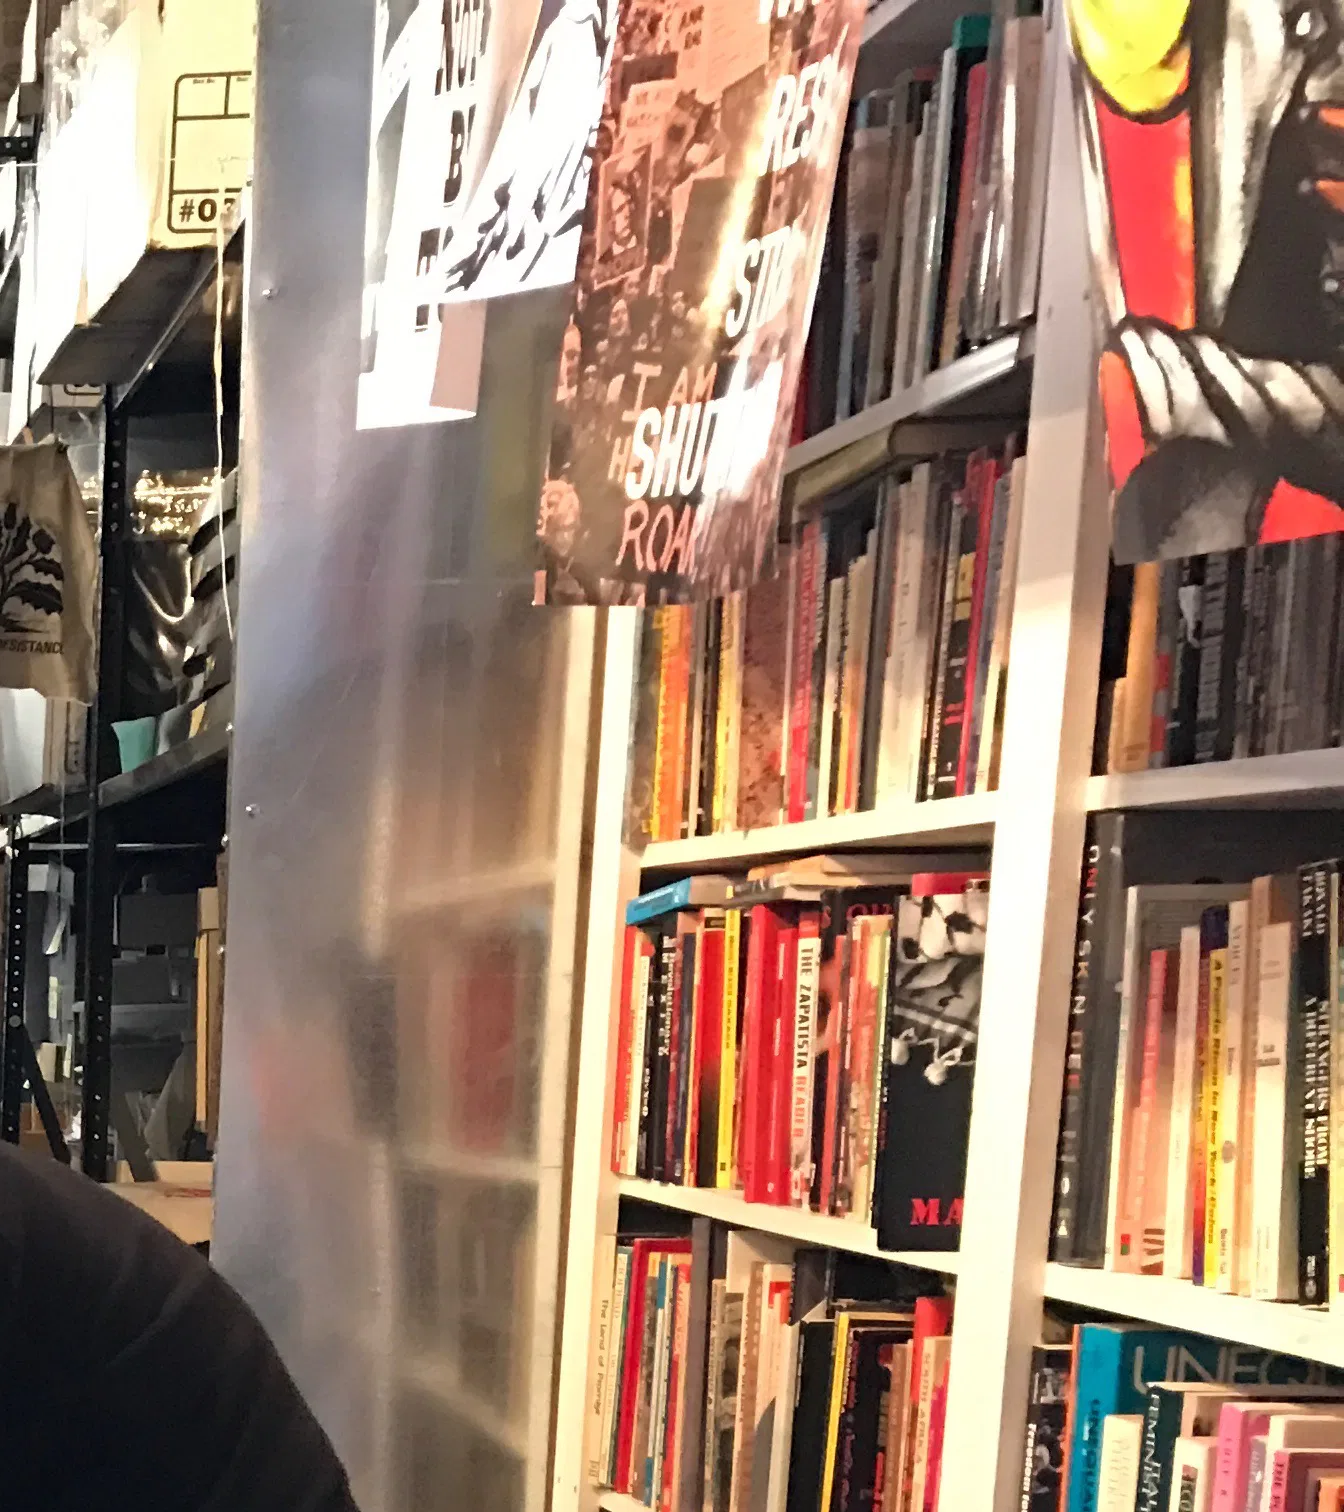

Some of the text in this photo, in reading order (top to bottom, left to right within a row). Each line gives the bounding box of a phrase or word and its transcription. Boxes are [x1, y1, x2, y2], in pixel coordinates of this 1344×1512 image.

[792, 946, 814, 1138] THE ZAPATISTA READER
[1022, 1423, 1037, 1492] Freedom
